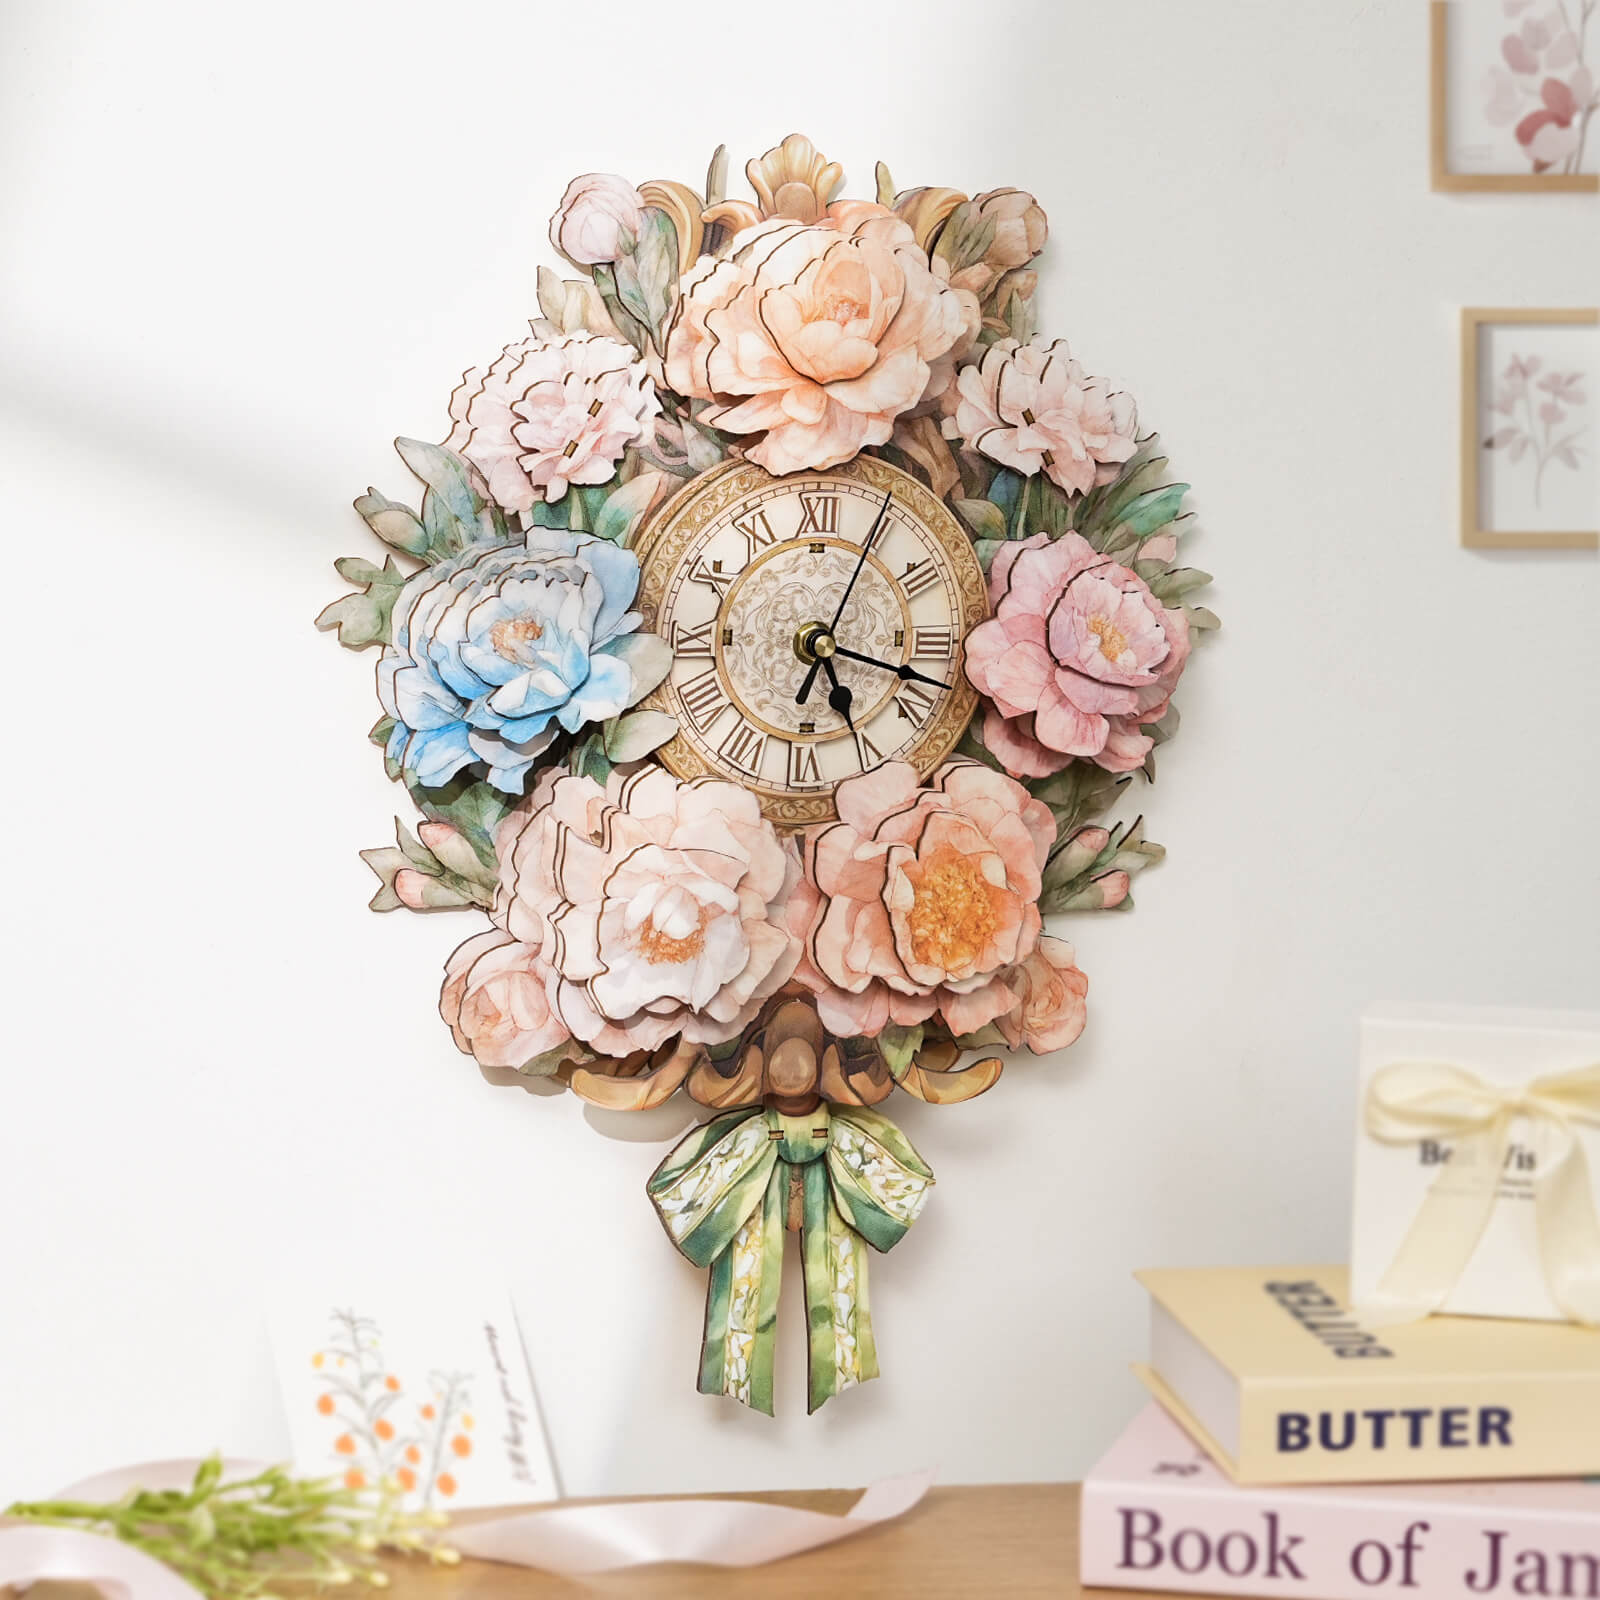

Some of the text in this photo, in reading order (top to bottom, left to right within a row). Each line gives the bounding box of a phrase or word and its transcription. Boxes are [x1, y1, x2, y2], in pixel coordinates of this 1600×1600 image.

[738, 509, 778, 555] XI
[801, 496, 840, 534] XII
[694, 561, 735, 597] X
[903, 566, 939, 596] II
[676, 625, 713, 655] IX
[915, 629, 951, 656] III
[681, 677, 728, 730] VIII
[903, 682, 937, 722] IV
[726, 724, 765, 772] VII
[792, 746, 822, 782] VI
[861, 732, 887, 768] V
[1276, 1407, 1513, 1452] BUTTER
[1115, 1506, 1600, 1598] Book of Jan
